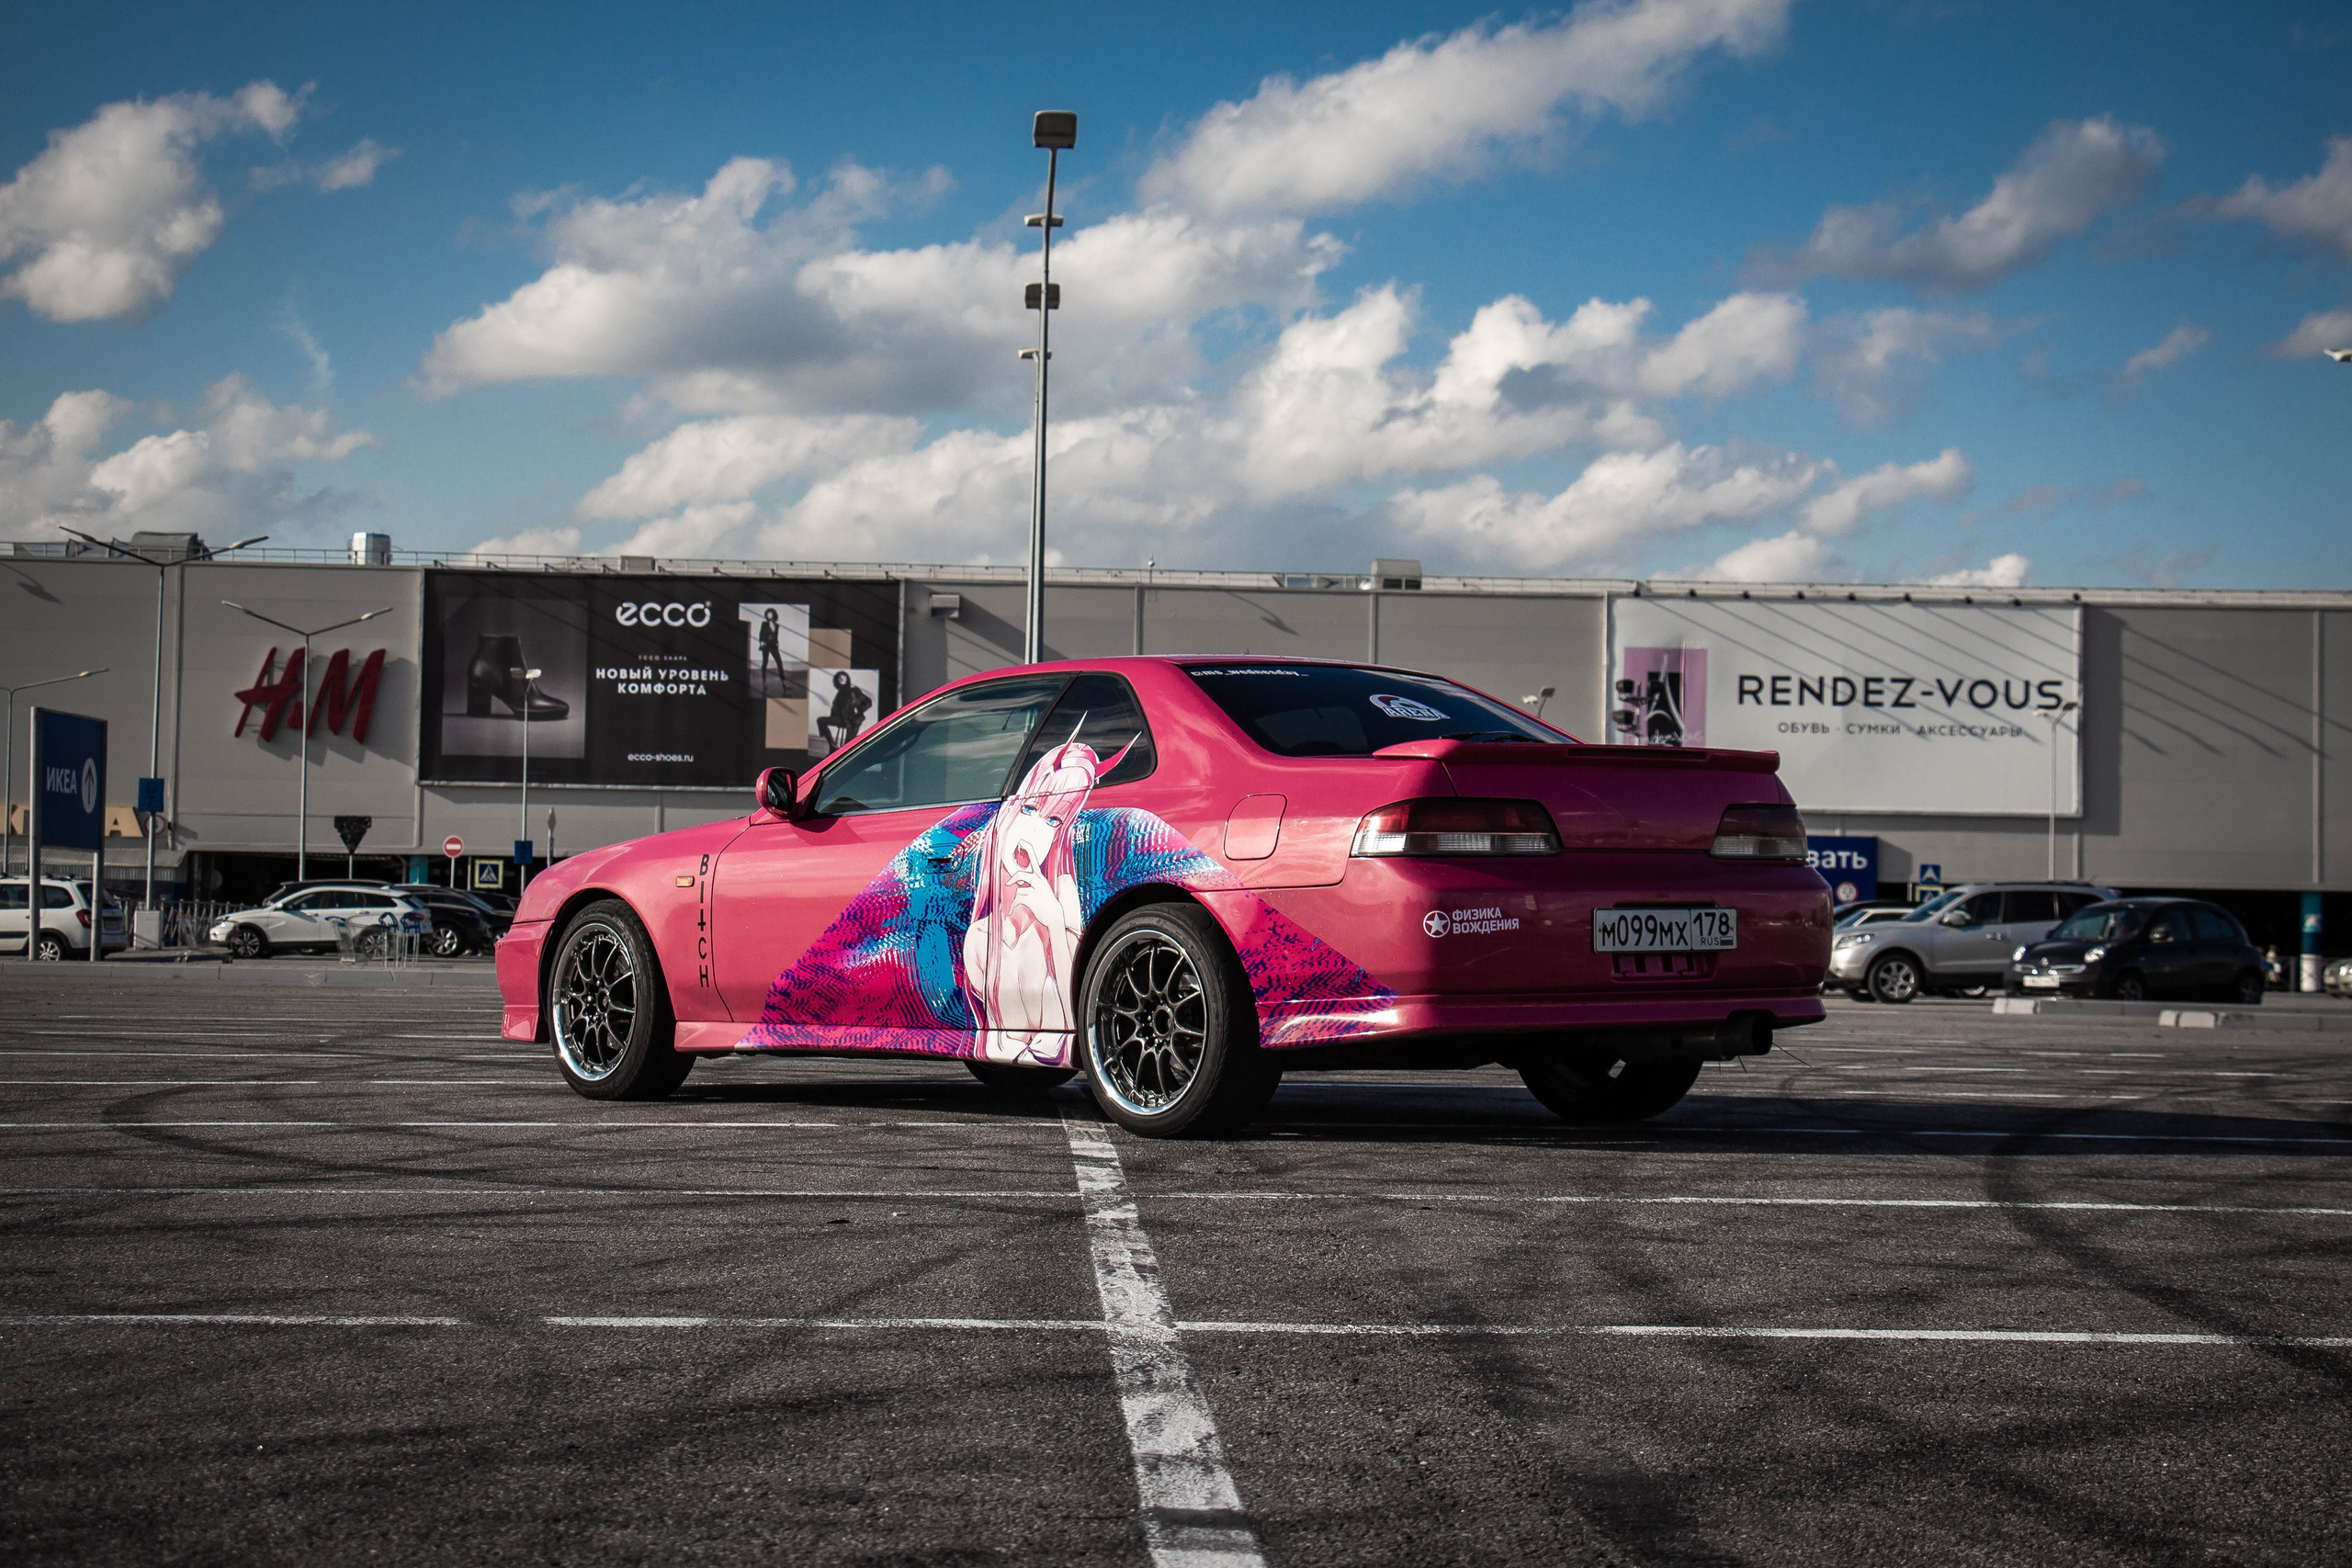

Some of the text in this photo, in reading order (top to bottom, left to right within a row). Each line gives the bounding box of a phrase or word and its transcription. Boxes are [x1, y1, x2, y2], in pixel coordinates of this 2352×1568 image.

[596, 666, 729, 682] НОВЫЙ УРОВЕНЬ
[234, 646, 386, 745] H&M
[617, 682, 707, 694] КОМФОРТА
[1737, 675, 2064, 710] RENDEZ-VOUS
[1778, 721, 2023, 738] ОБУВЬ СУМКИ АКСЕССУАРЫ
[628, 752, 695, 762] ecco-shoes.ru
[47, 767, 77, 794] ИКЕА
[1452, 907, 1502, 921] ФИЗИКА
[1453, 918, 1520, 934] ВОЖДЕНИЯ
[1693, 911, 1730, 937] 178
[1701, 937, 1720, 946] RUS
